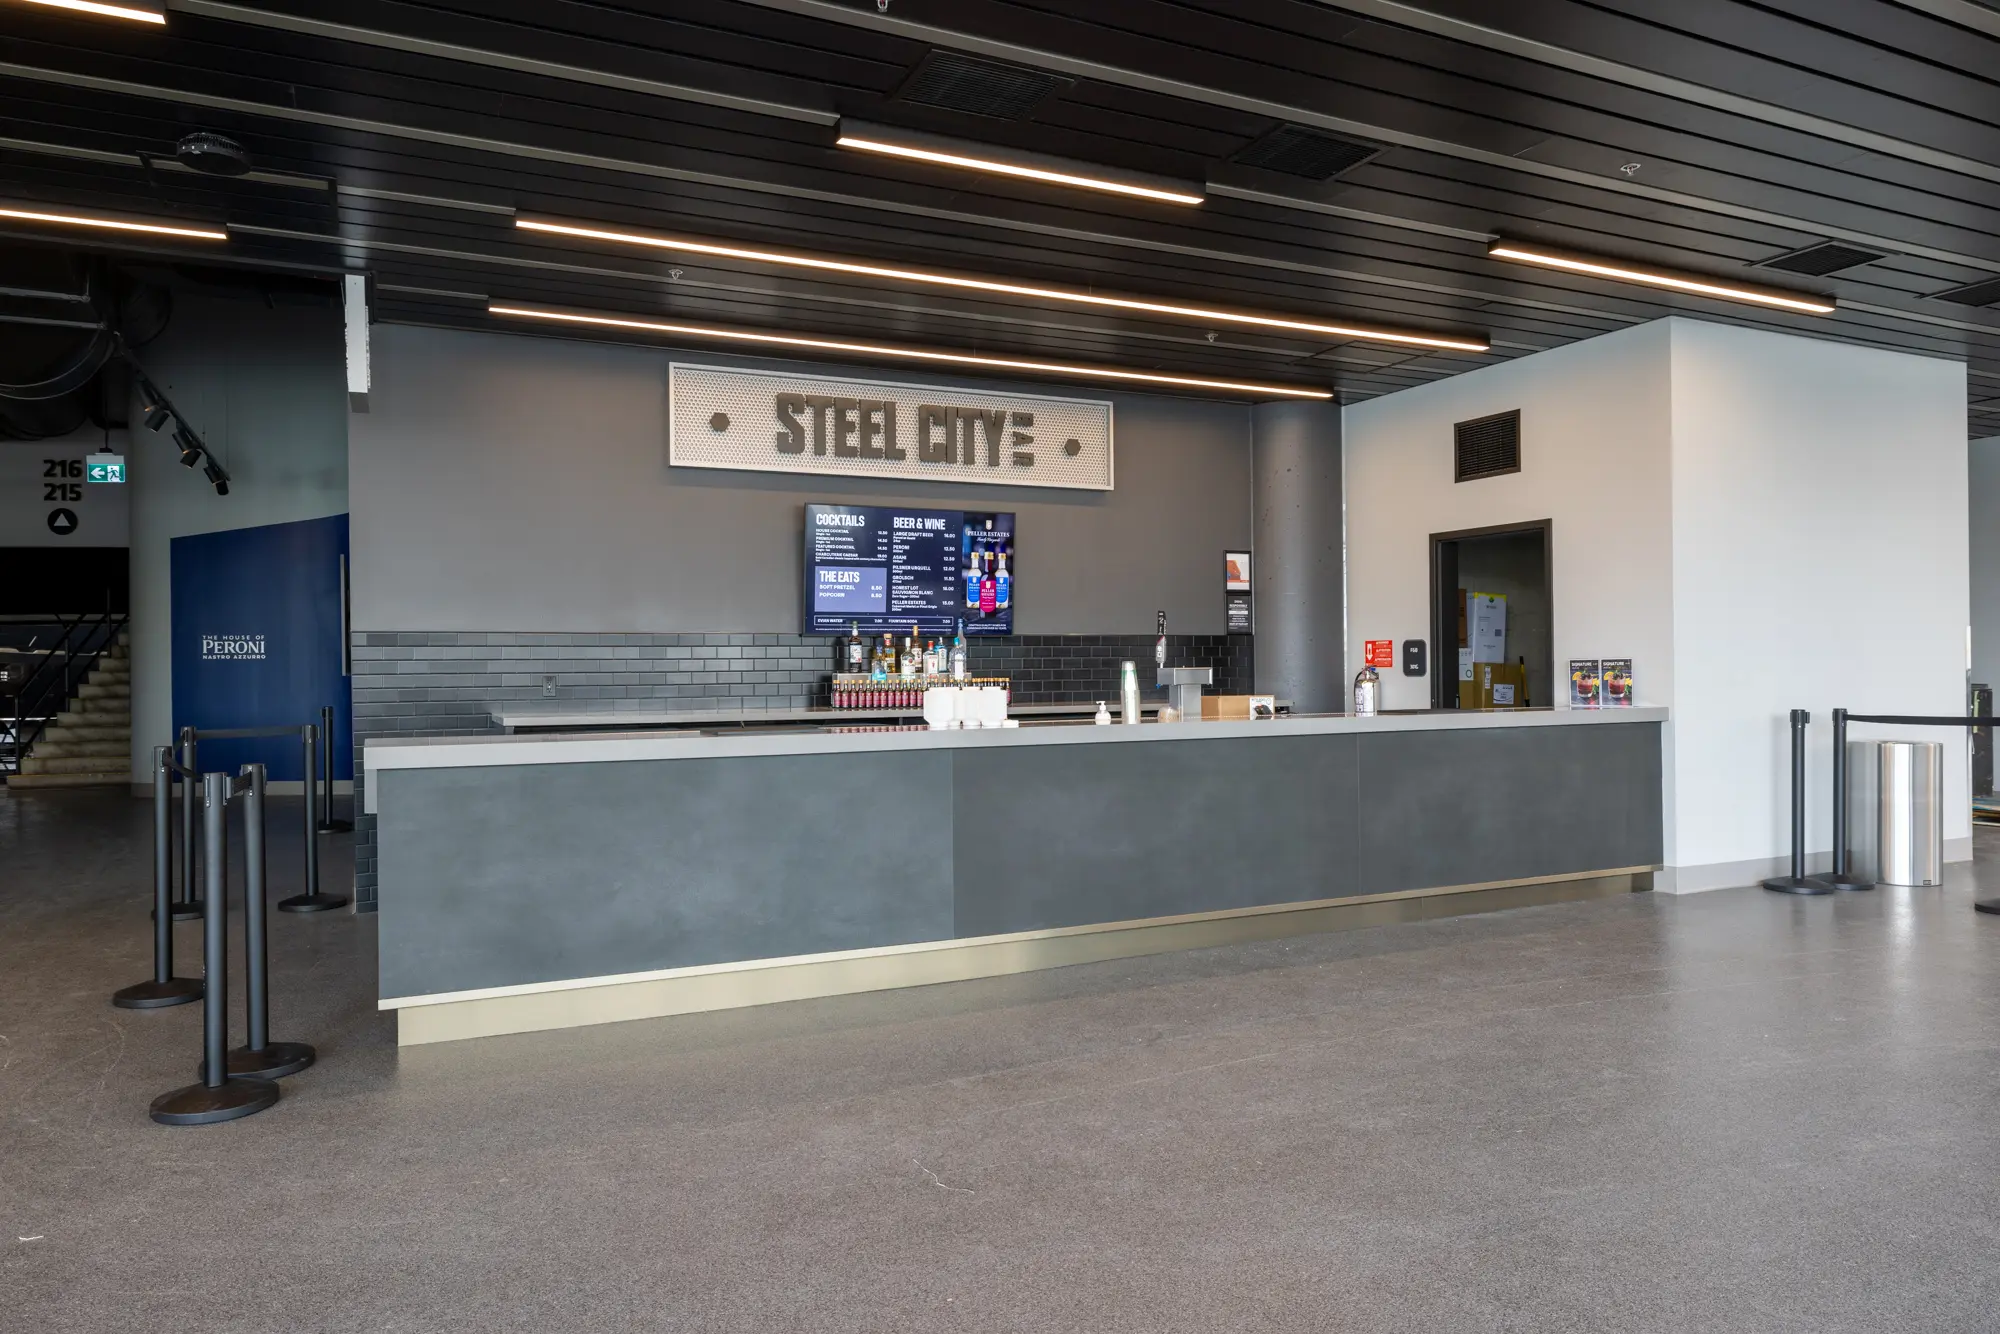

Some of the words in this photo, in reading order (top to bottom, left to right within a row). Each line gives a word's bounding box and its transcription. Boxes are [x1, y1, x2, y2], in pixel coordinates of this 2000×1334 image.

[776, 392, 906, 461] STEEL
[918, 404, 1007, 467] CITY
[1012, 411, 1035, 467] BAR
[43, 459, 82, 478] 216
[43, 483, 82, 501] 215
[816, 513, 865, 527] COCKTAILS
[893, 516, 915, 529] BEER
[916, 518, 923, 529] &
[924, 518, 946, 530] WINE
[820, 570, 837, 582] THE
[838, 571, 860, 583] EATS
[202, 639, 265, 654] PERONI
